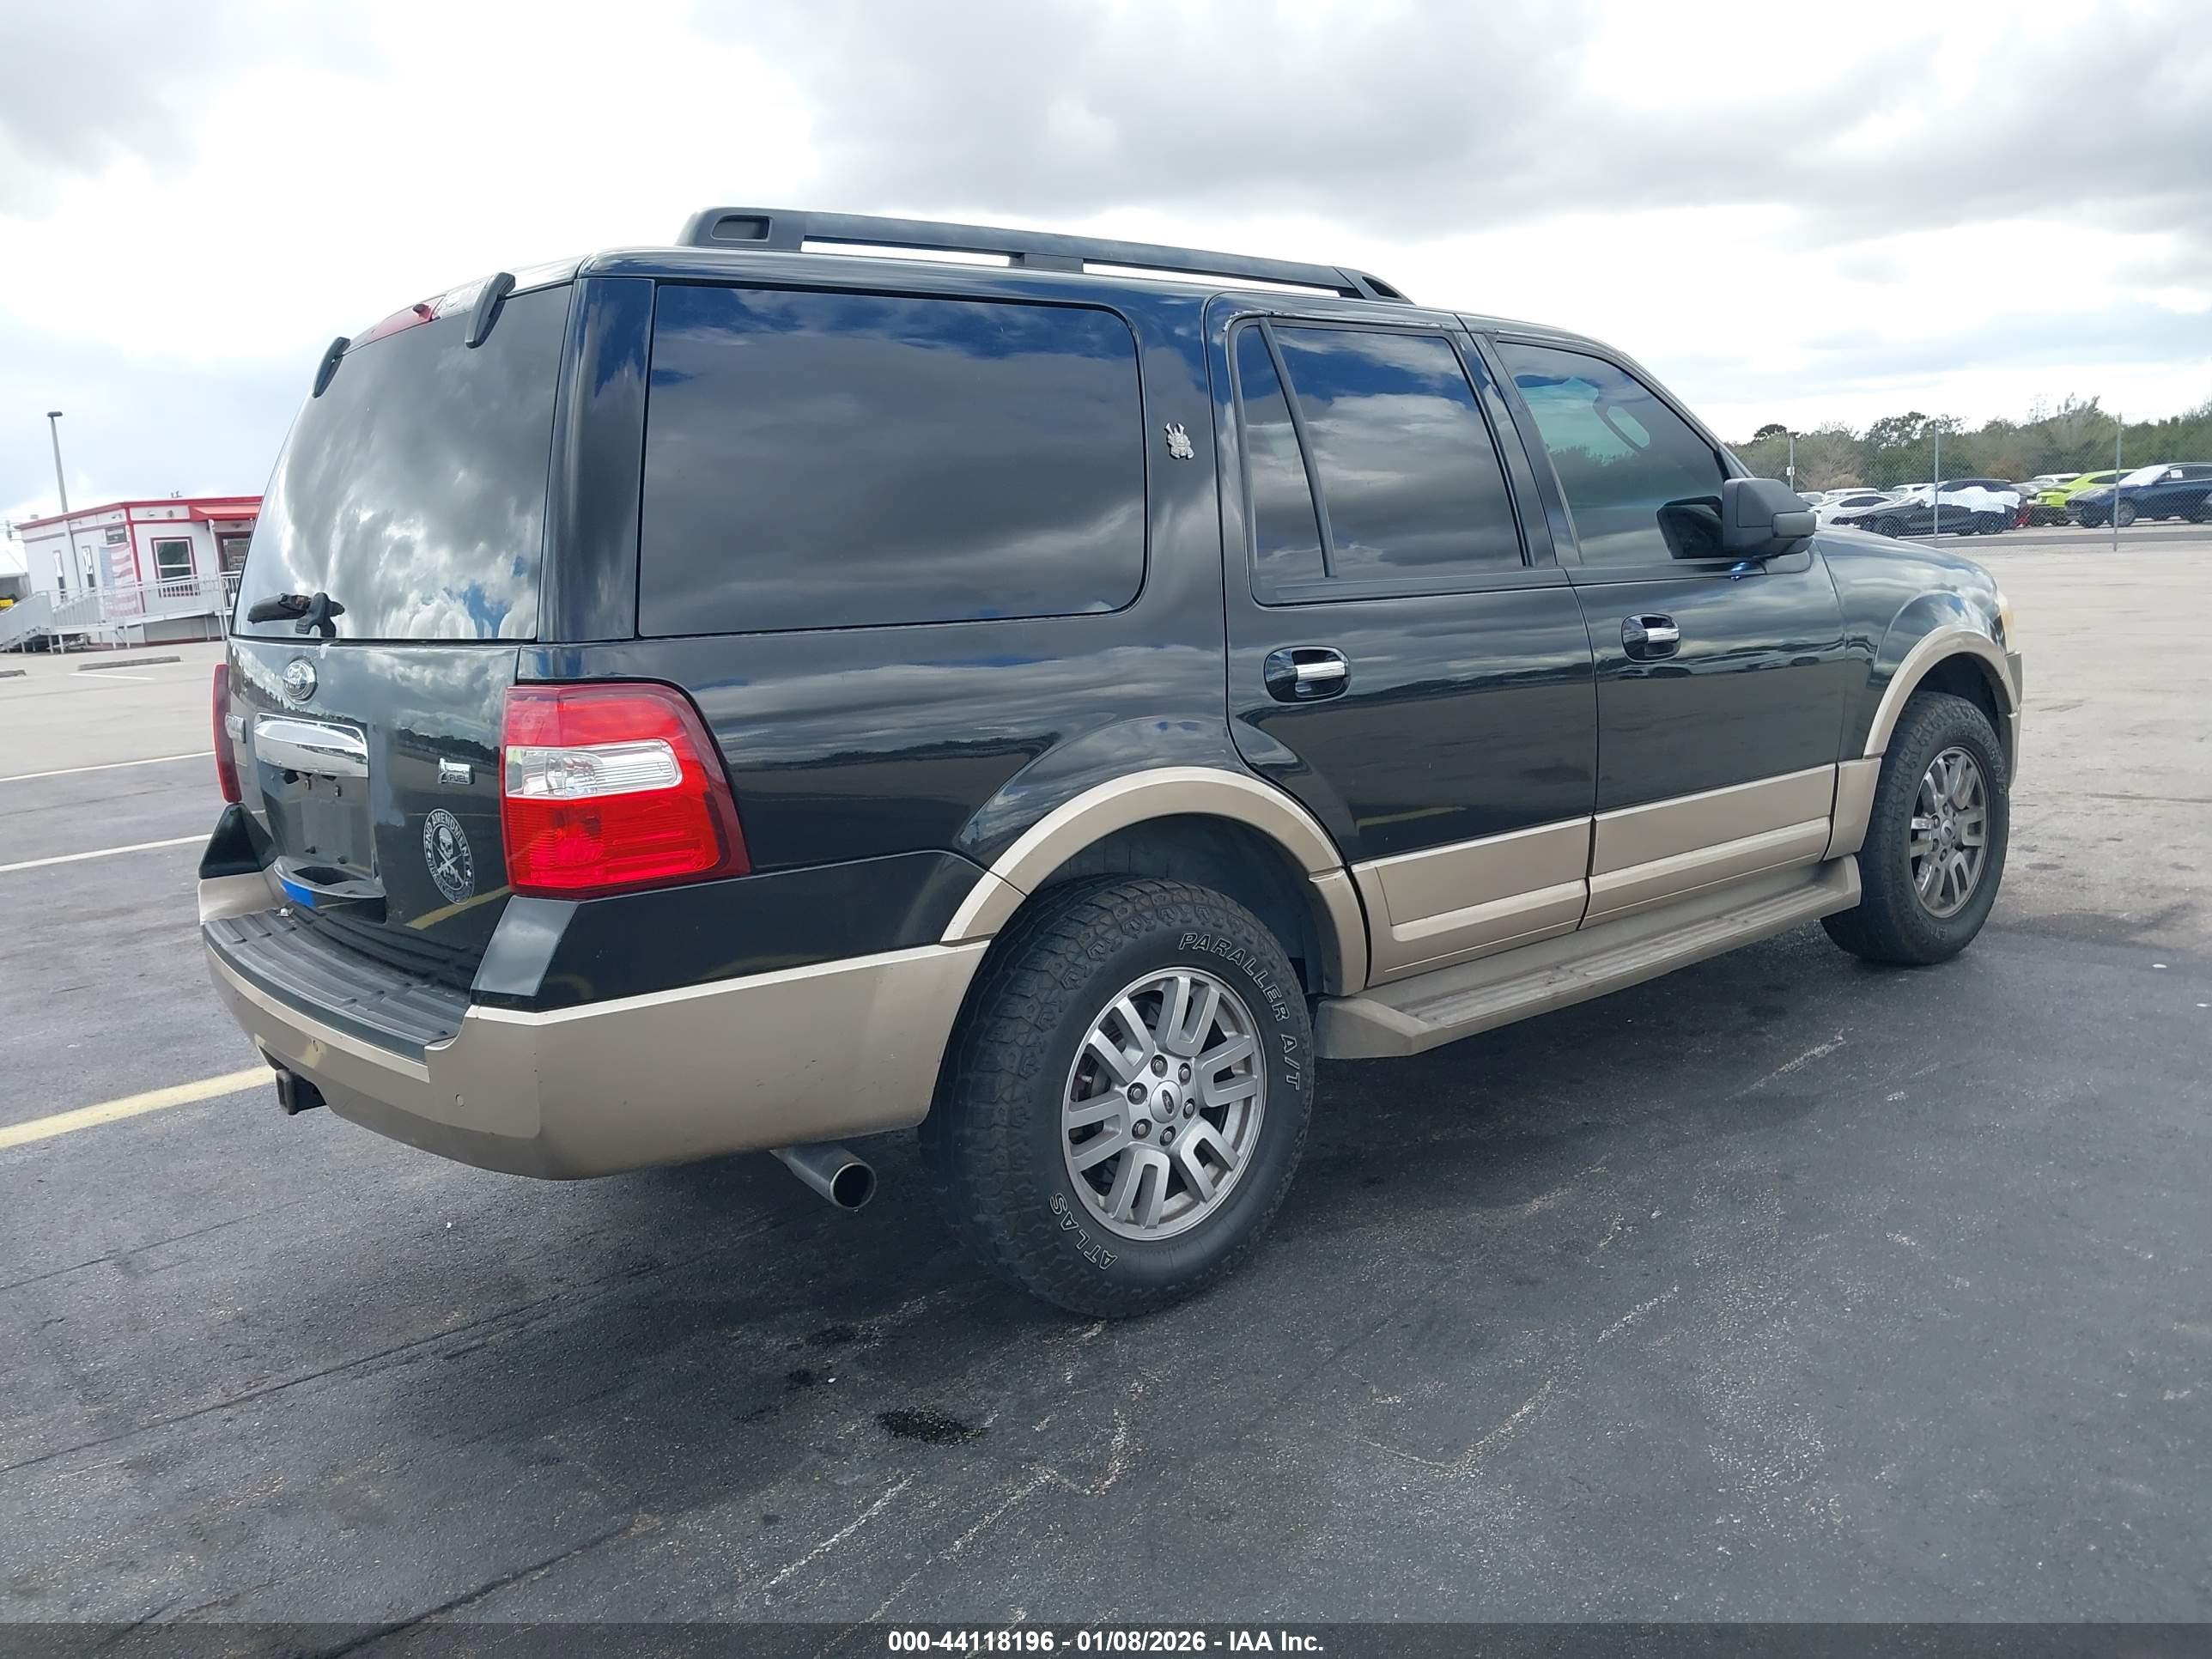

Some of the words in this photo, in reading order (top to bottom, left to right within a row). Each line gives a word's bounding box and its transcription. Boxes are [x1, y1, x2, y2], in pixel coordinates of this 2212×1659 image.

[1179, 933, 1290, 1022] PARALLER
[1280, 1034, 1301, 1091] A/T
[1049, 1193, 1118, 1270] ATLAS
